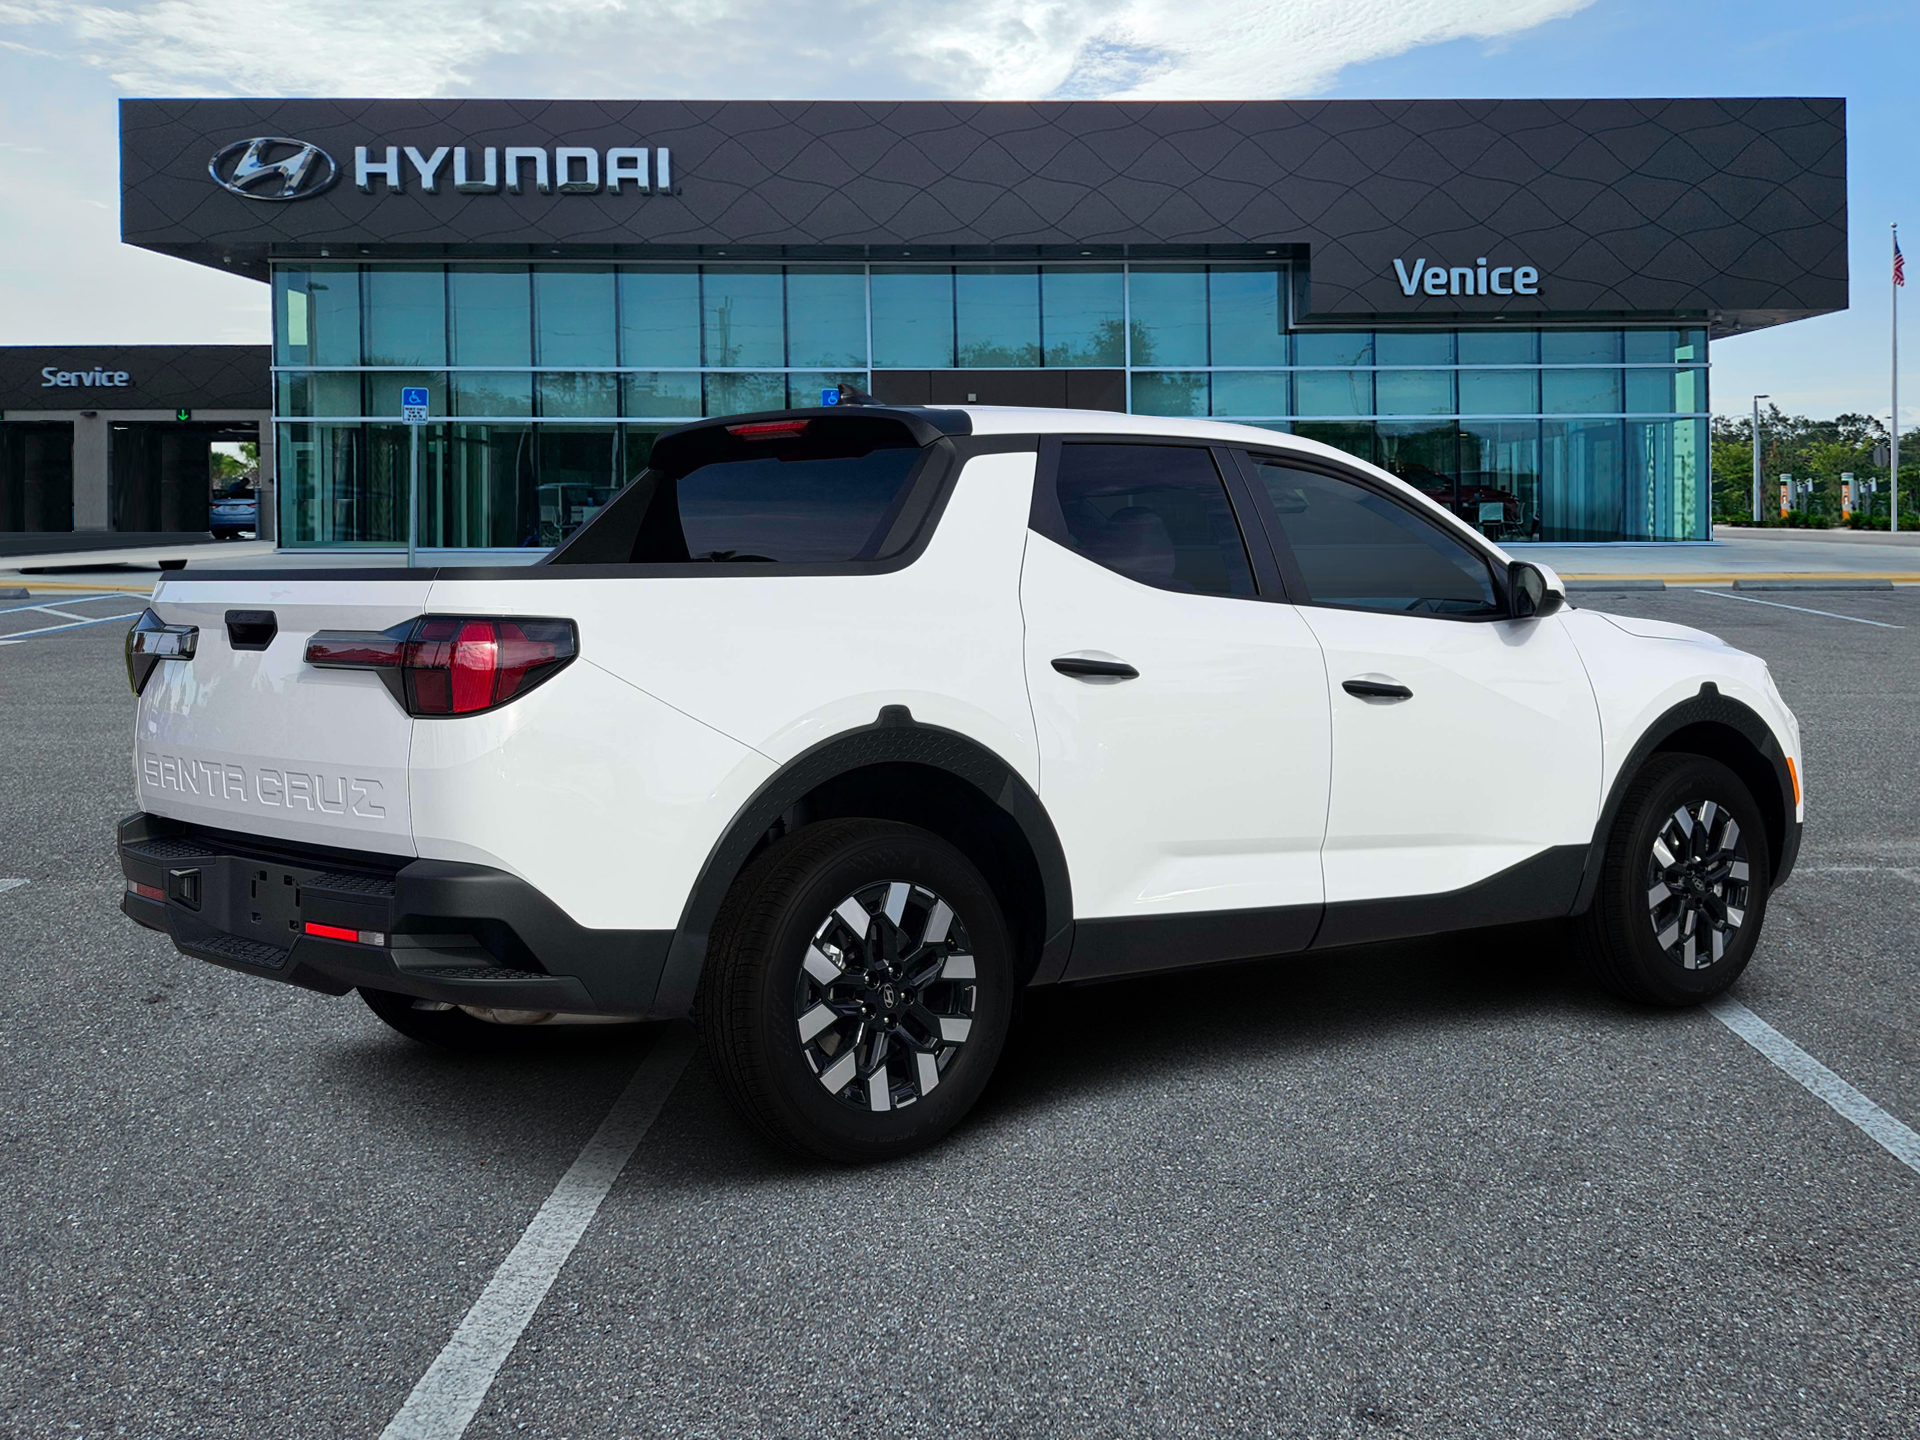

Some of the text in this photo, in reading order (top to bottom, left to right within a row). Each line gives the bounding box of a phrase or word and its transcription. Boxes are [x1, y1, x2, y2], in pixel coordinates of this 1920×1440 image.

[354, 145, 672, 195] HYUNDAI
[1392, 256, 1540, 296] Venice
[41, 366, 130, 388] Service
[143, 751, 386, 819] SANTA CRUZ
